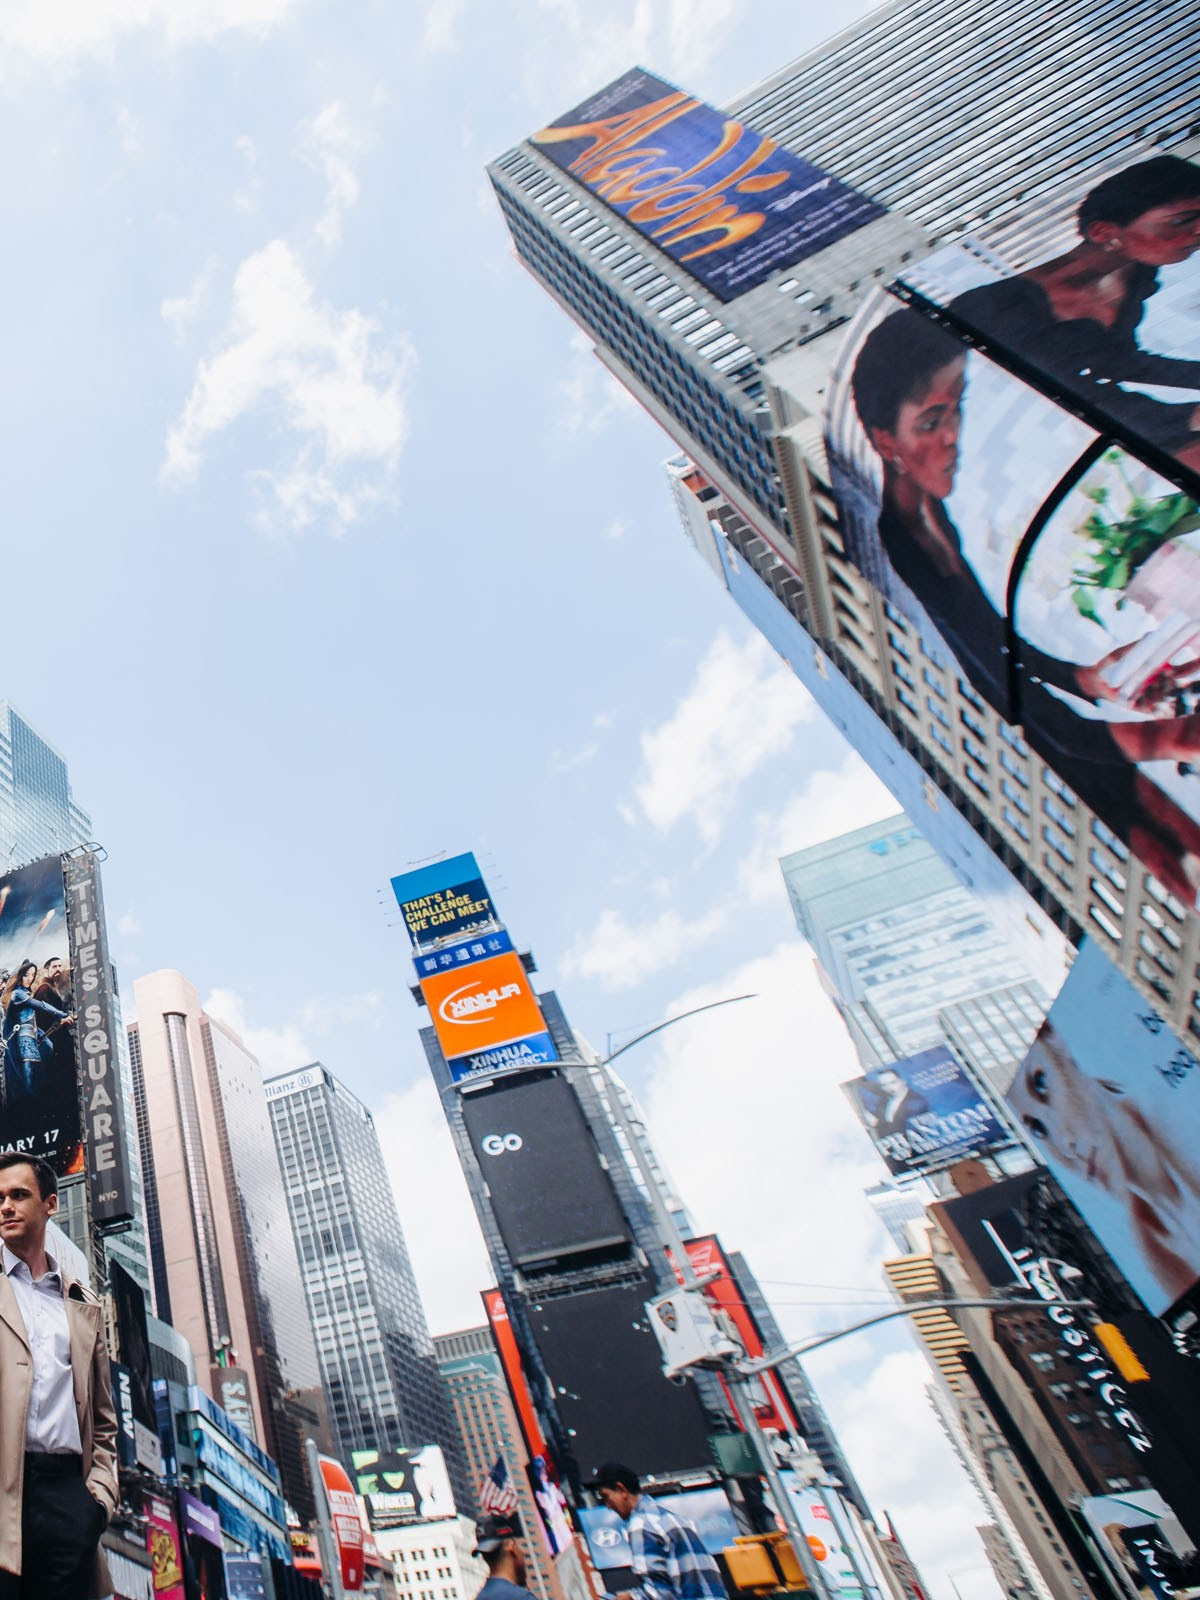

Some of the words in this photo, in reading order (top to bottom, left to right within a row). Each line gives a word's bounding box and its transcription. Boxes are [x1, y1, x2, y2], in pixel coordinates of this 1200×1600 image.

[531, 91, 791, 262] Aladdin
[402, 892, 443, 913] THAT'S
[445, 888, 456, 900] A
[405, 893, 473, 923] CHALLENGE
[408, 919, 430, 932] WE
[430, 911, 456, 926] CAN
[457, 898, 490, 918] MEET
[69, 878, 99, 993] TIMES
[458, 1064, 497, 1082] NEWS
[496, 1051, 549, 1071] AGENCY
[468, 1043, 533, 1070] XINHUA
[82, 1003, 116, 1174] SQUARE
[43, 1128, 60, 1145] 17
[98, 1188, 119, 1203] NYC
[118, 1371, 135, 1440] NEW
